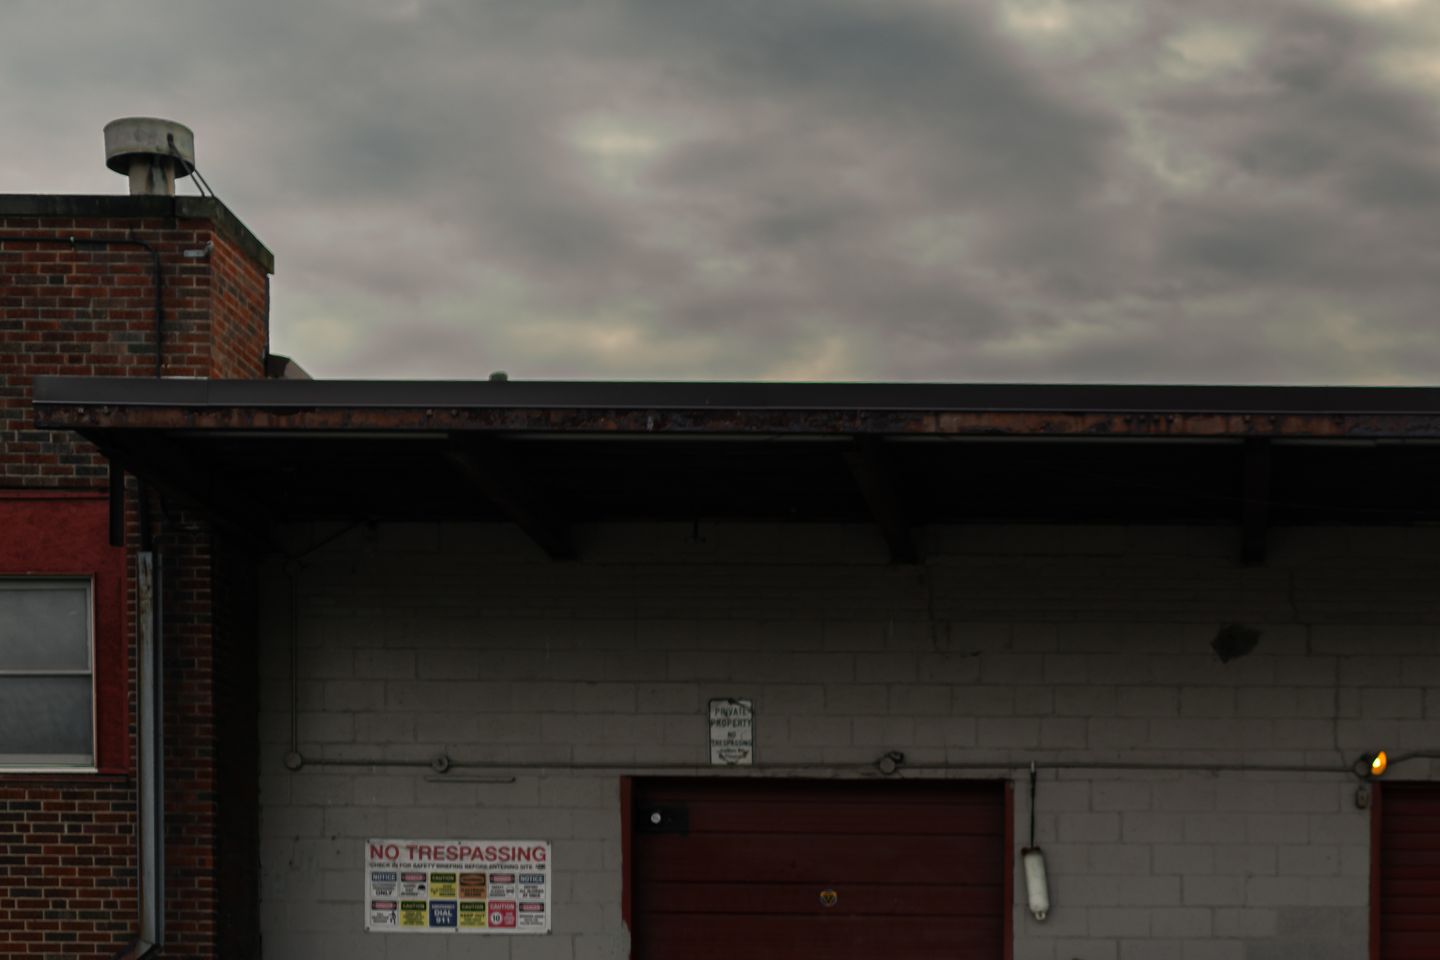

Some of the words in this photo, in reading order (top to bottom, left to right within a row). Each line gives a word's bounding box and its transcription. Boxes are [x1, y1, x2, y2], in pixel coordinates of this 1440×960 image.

[710, 718, 752, 728] PROPERTY
[370, 844, 399, 860] NO
[406, 845, 546, 862] TRESPASSING
[434, 909, 452, 917] DIAL
[492, 914, 501, 922] 10
